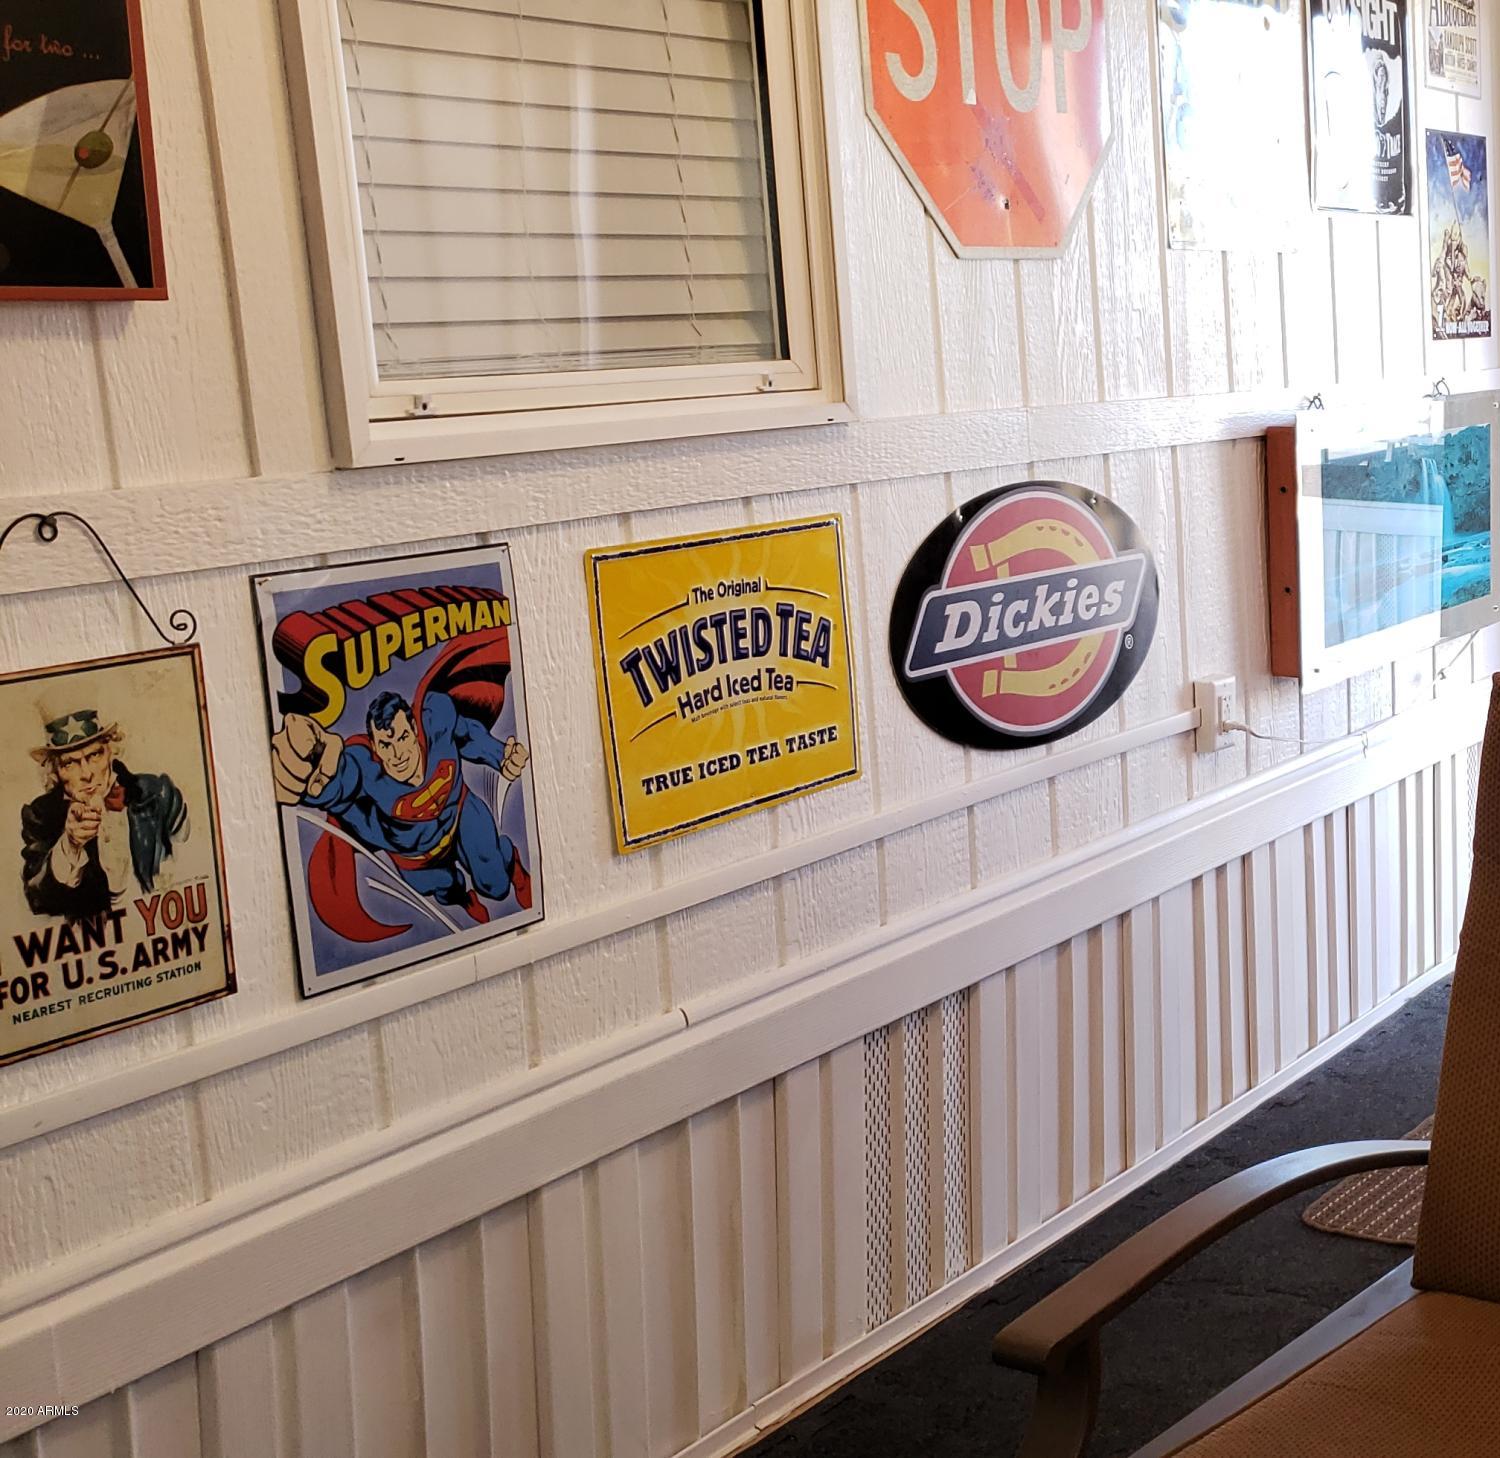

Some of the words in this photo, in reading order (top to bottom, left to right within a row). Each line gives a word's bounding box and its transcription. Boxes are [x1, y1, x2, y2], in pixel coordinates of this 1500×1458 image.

[2, 24, 32, 61] for
[40, 32, 74, 57] two
[691, 585, 715, 605] The
[717, 577, 761, 599] Original
[934, 578, 1126, 653] Dickies
[303, 599, 512, 729] SUPERMAN
[619, 606, 773, 708] TWISTED
[775, 602, 833, 668] TEA
[677, 674, 722, 719] Hard
[727, 671, 762, 699] Iced
[765, 667, 794, 692] Tea
[641, 766, 694, 796] TRUE
[698, 751, 742, 781] ICED
[746, 739, 782, 766] TEA
[785, 725, 838, 755] TASTE
[13, 908, 127, 969] WANT
[133, 882, 209, 937] YOU
[0, 971, 51, 1011] FOR
[131, 923, 209, 972] ARMY
[12, 998, 72, 1025] NEAREST
[78, 977, 152, 1006] RECRUITING
[156, 961, 202, 983] STATION
